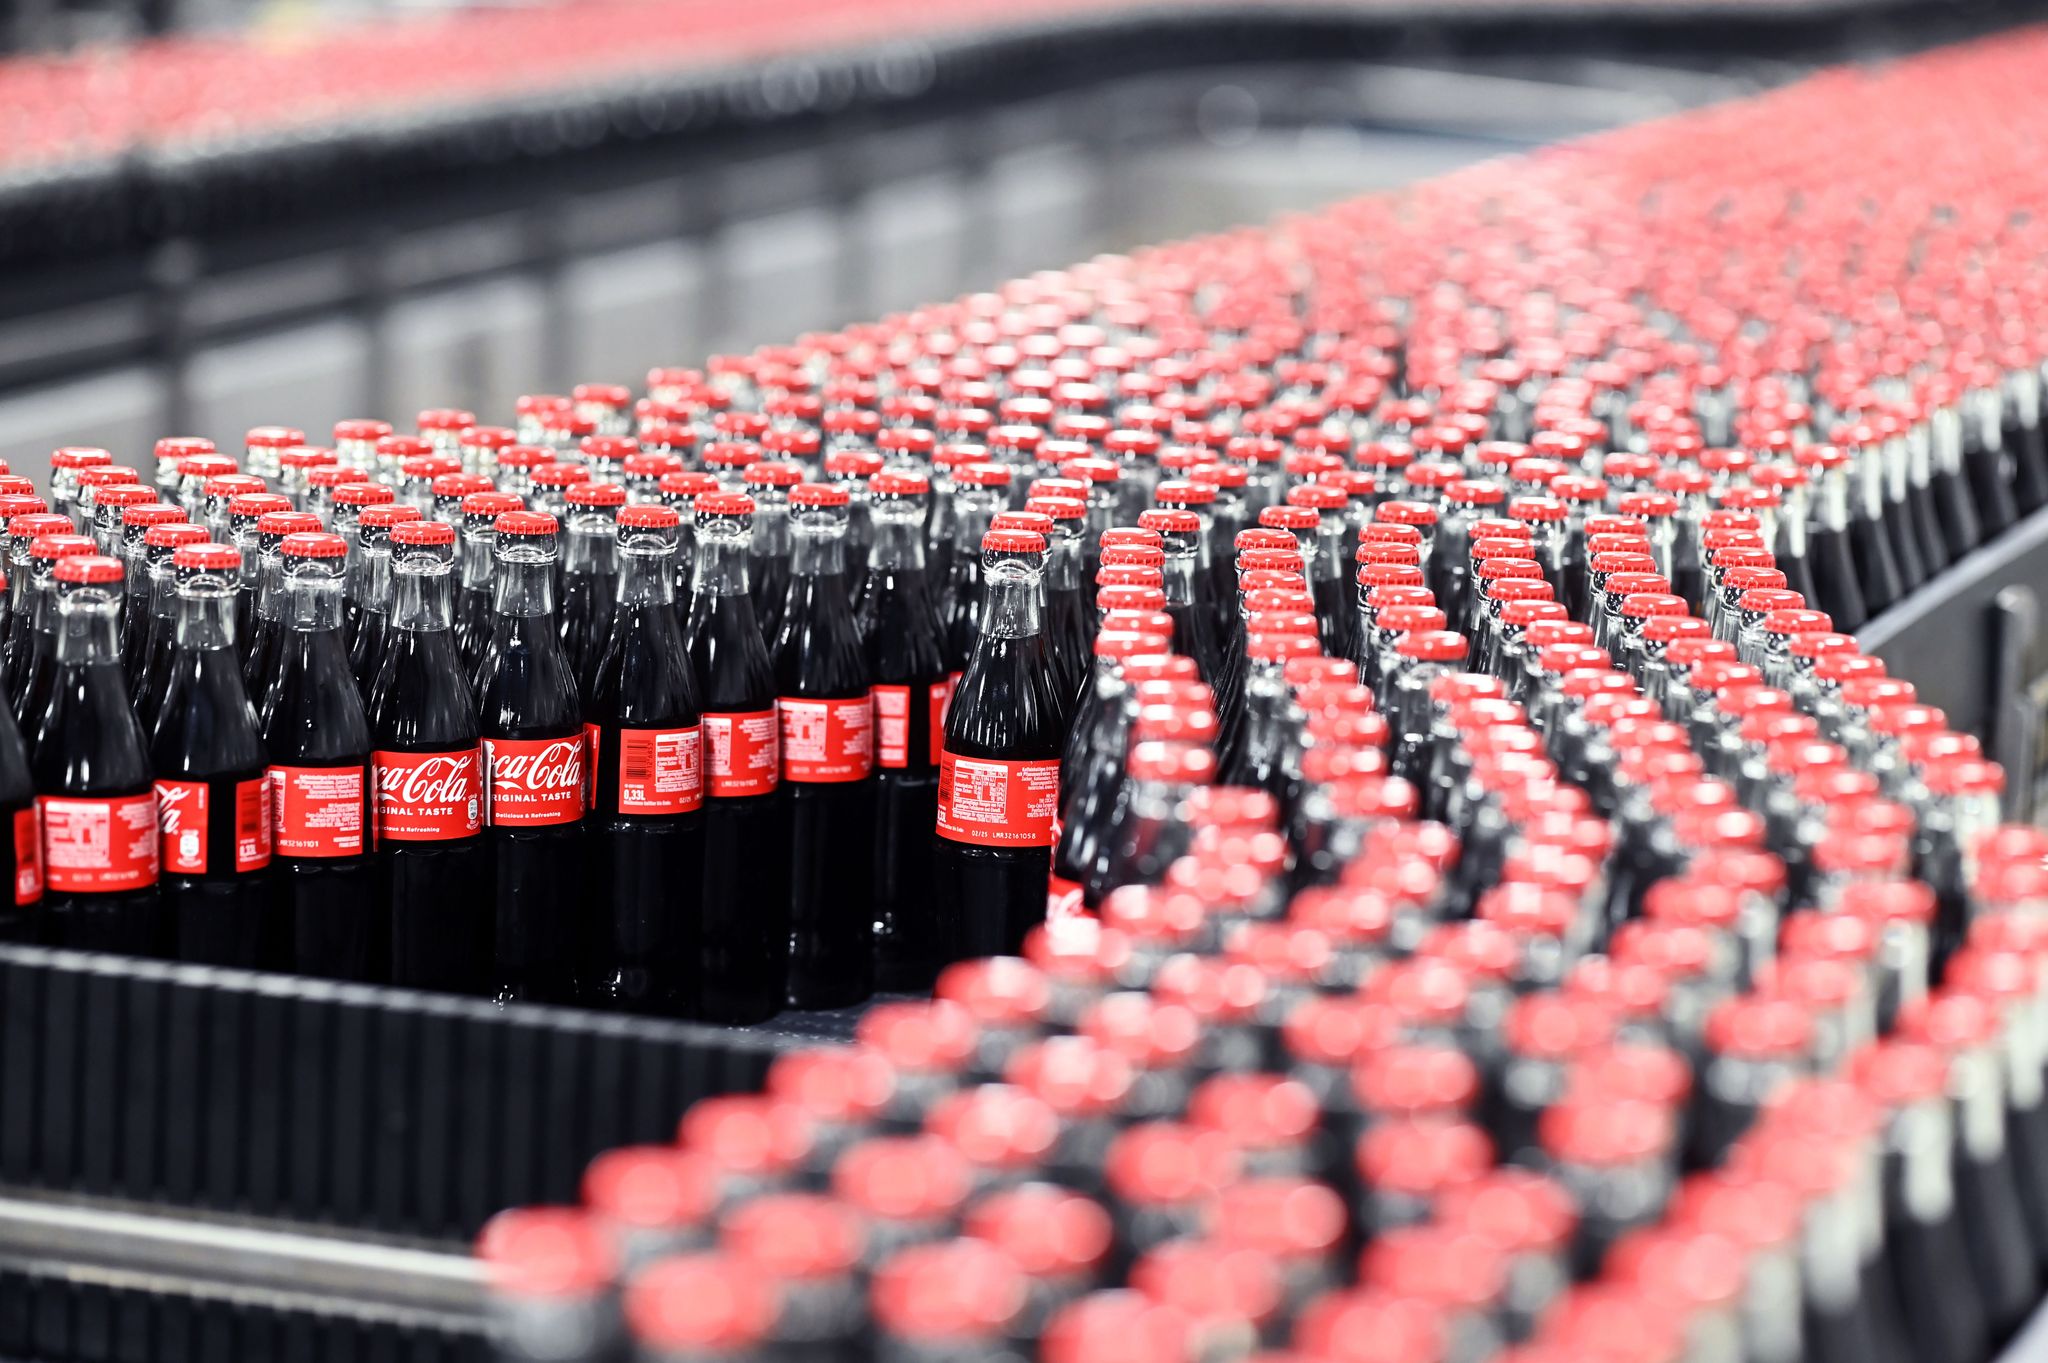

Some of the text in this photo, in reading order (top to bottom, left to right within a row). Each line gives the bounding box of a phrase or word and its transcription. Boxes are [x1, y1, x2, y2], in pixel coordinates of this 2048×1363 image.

[491, 740, 584, 790] ca-Cola
[541, 791, 572, 802] TASTE
[623, 789, 646, 801] 0,33L
[418, 807, 454, 816] TASTE
[495, 811, 524, 819] Delicious
[530, 811, 562, 819] Refreshing
[971, 830, 1037, 840] 02/25 LMR32161058
